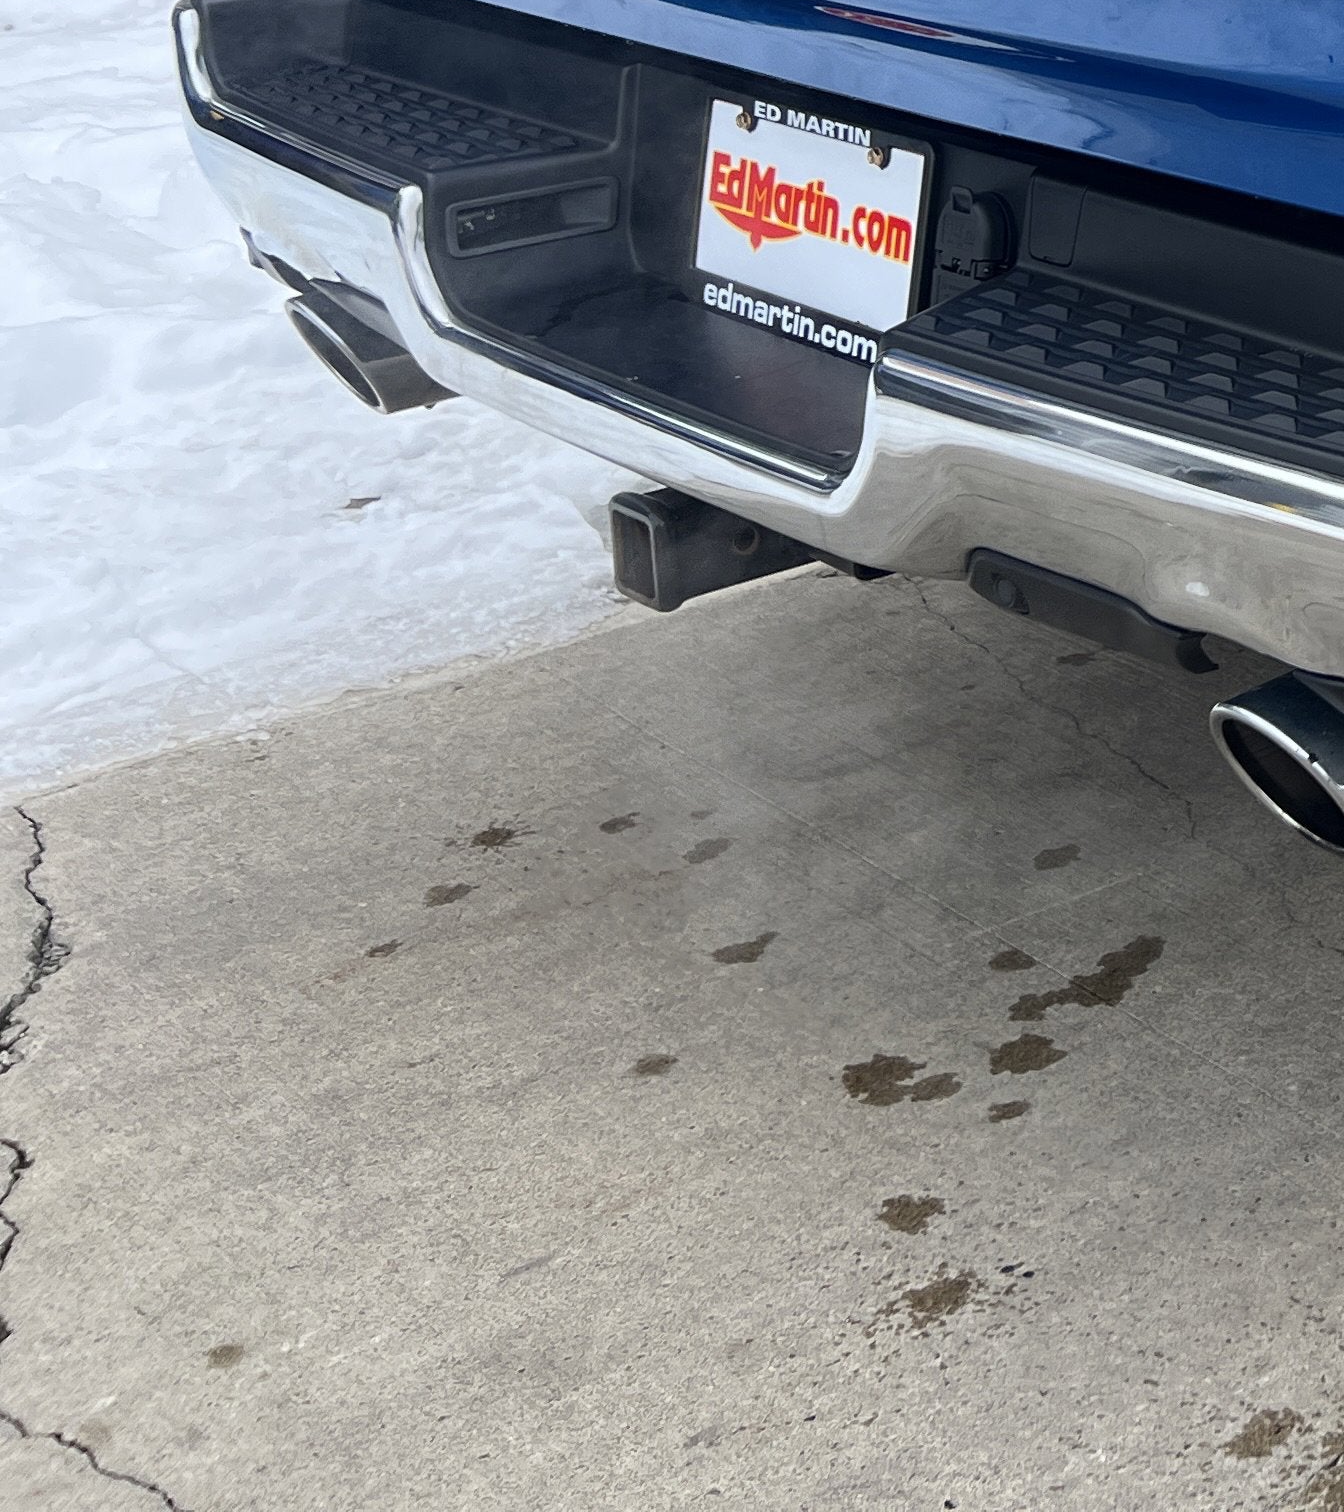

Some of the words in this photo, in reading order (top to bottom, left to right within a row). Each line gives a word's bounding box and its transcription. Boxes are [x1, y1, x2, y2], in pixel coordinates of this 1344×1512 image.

[754, 100, 782, 122] ED
[786, 111, 871, 147] MARTIN
[704, 282, 878, 363] edmartin.com
